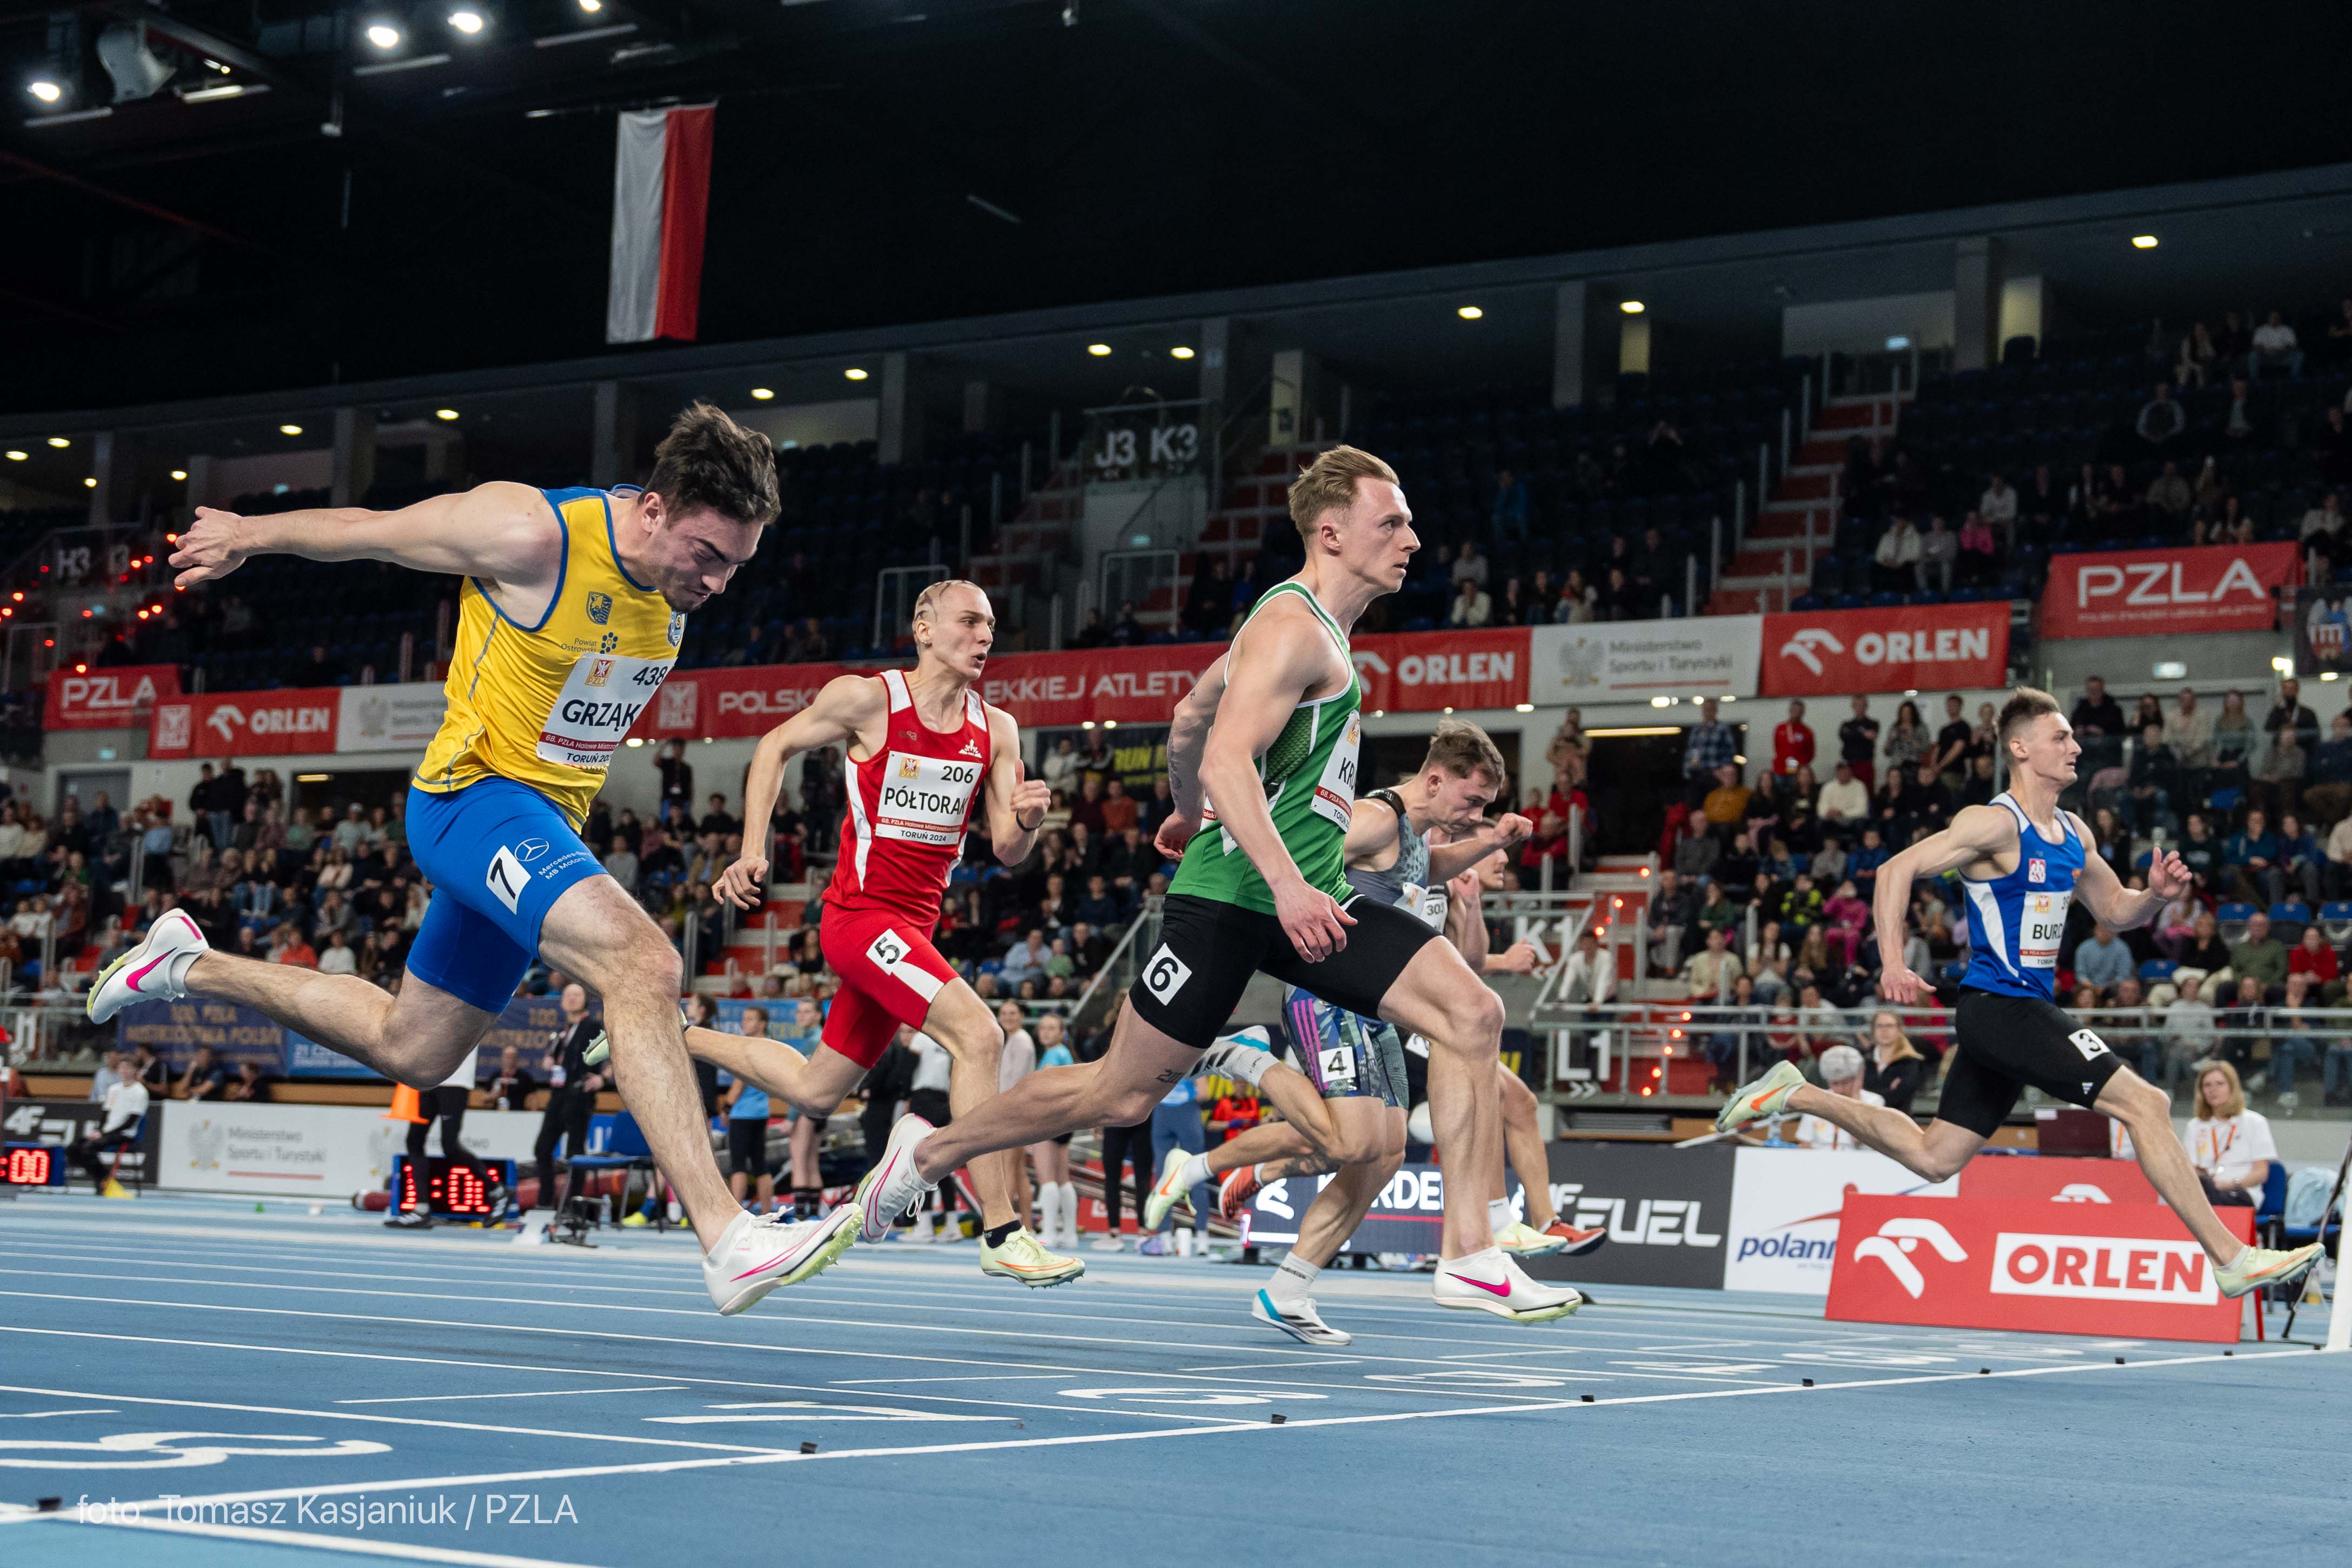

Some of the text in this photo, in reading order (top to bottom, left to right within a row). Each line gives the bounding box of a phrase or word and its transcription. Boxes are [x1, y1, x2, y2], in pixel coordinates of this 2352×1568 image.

[1094, 424, 1199, 467] J3 K3
[2078, 557, 2266, 608] PZLA
[574, 637, 597, 647] Powiat
[1855, 628, 1990, 665] ORLEN
[633, 666, 668, 686] 438
[1397, 651, 1514, 686] ORLEN
[61, 675, 157, 710] PZLA
[250, 706, 330, 735] ORLEN
[562, 699, 642, 732] GRZĄK
[546, 734, 556, 743] 68.
[558, 738, 574, 747] PZLA
[567, 752, 609, 763] TORUŃ 20
[941, 766, 974, 783] 206
[885, 786, 969, 815] PÓŁTORAK
[901, 830, 928, 840] TORUŃ
[490, 857, 516, 900] 7
[545, 857, 586, 880] MB Motors
[874, 936, 900, 964] 5
[1514, 916, 1573, 965] K1
[1150, 956, 1178, 992] 6
[1557, 1029, 1611, 1081] L1
[2079, 1032, 2101, 1052] 3
[1328, 1051, 1347, 1075] 4
[1574, 1198, 1722, 1247] FUEL
[2007, 1245, 2204, 1292] ORLEN
[1364, 1371, 1614, 1387] 5
